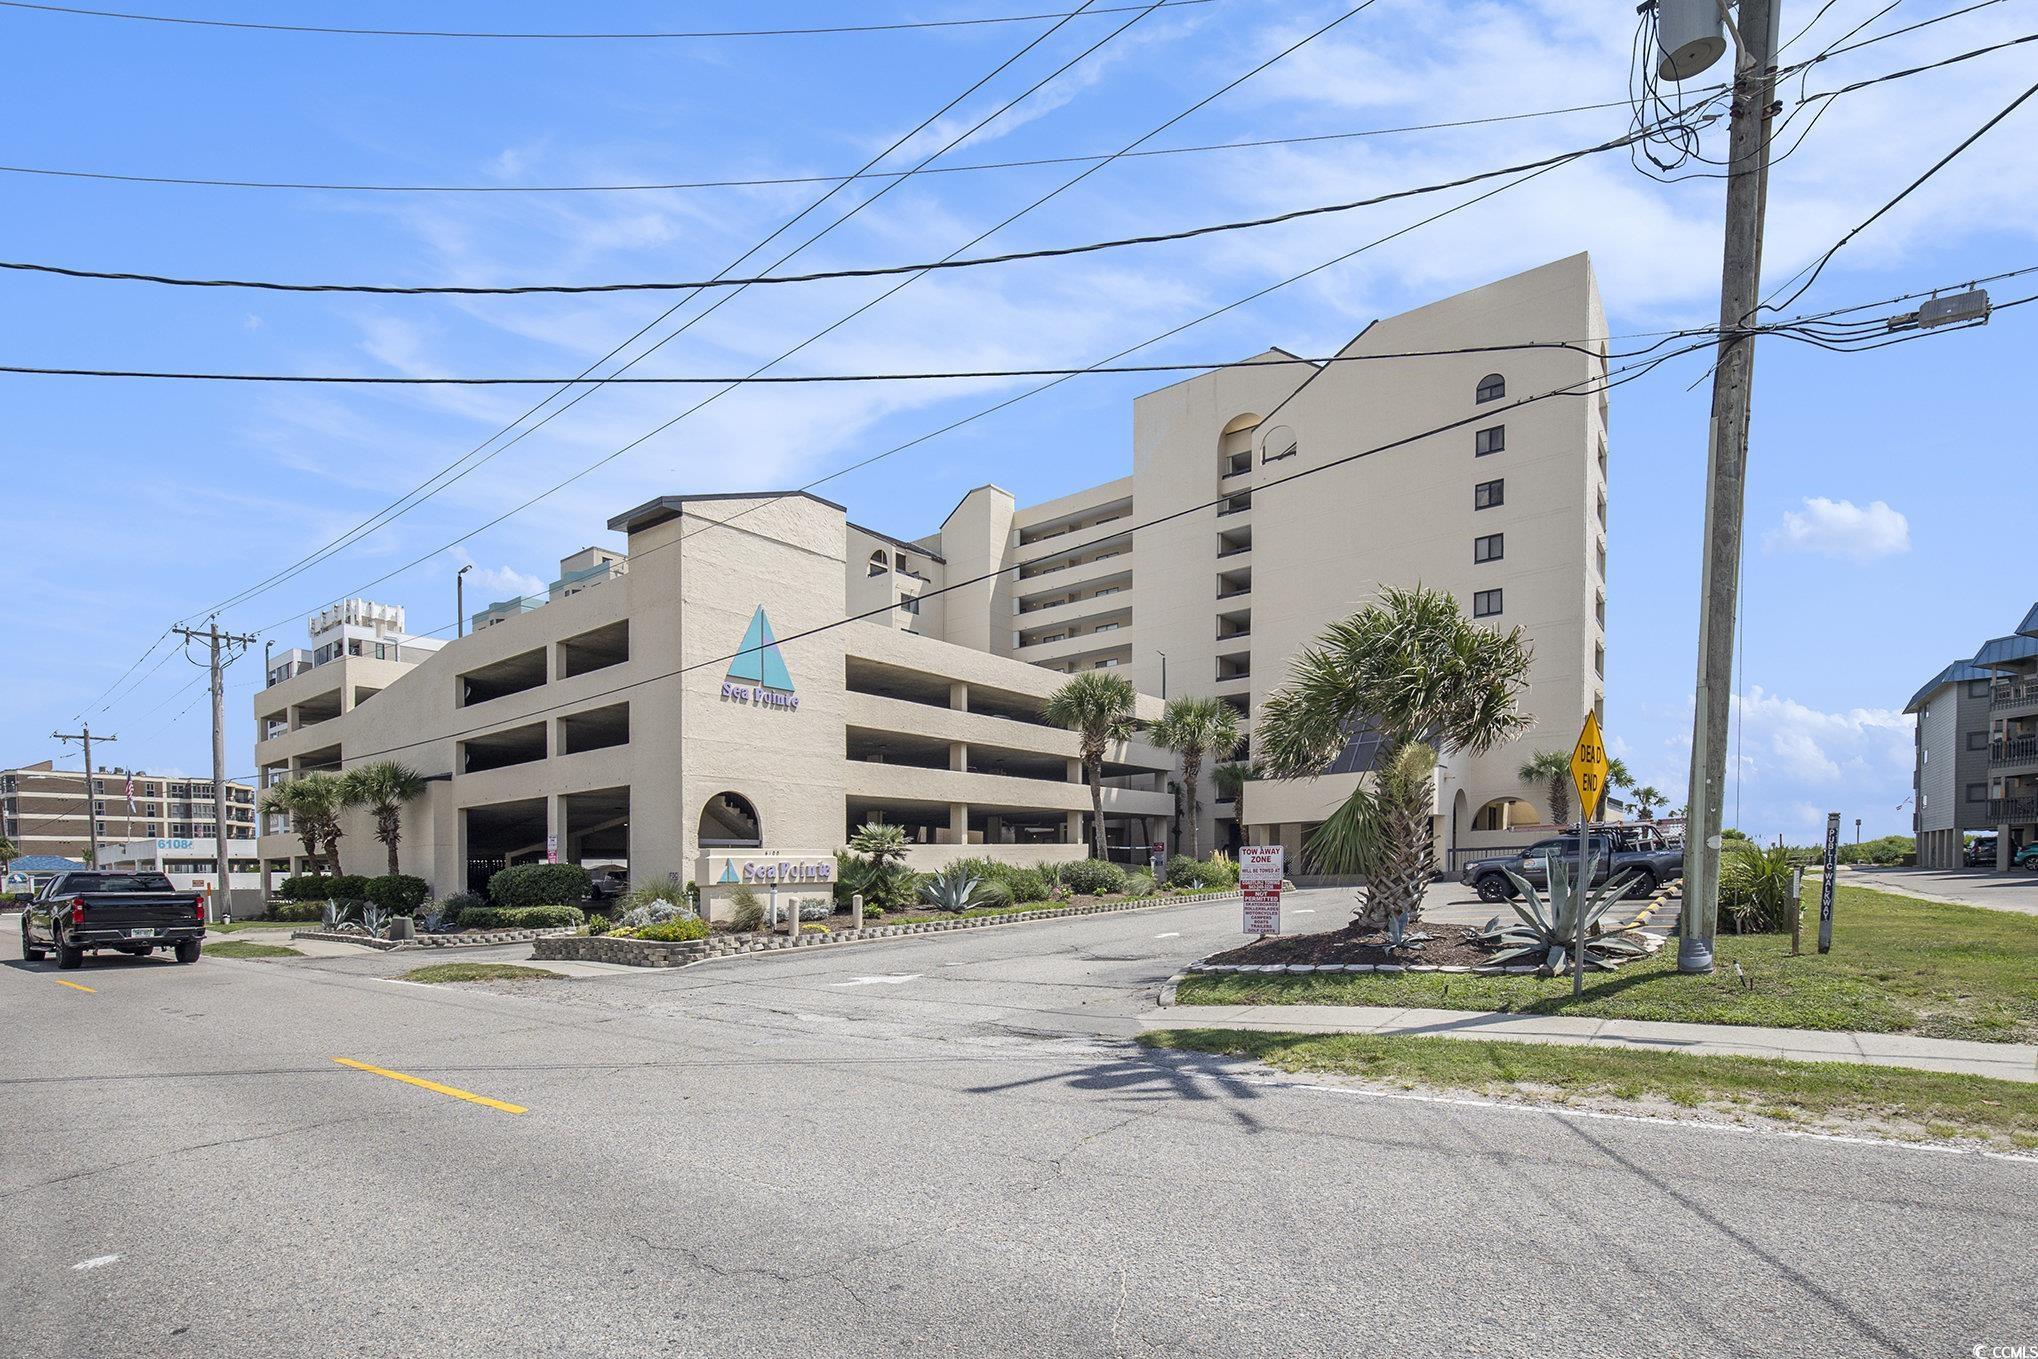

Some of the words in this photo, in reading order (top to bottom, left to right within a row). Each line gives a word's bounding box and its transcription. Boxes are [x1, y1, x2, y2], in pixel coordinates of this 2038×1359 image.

[721, 681, 749, 700] Sea
[754, 687, 799, 707] Pointe
[1581, 744, 1602, 763] DEAD
[1583, 773, 1598, 791] END
[1251, 855, 1271, 863] ZONE
[1827, 829, 1835, 870] PUBLIC
[743, 860, 777, 880] Sea
[779, 860, 831, 879] Pointe
[1823, 873, 1834, 920] WALKWAY
